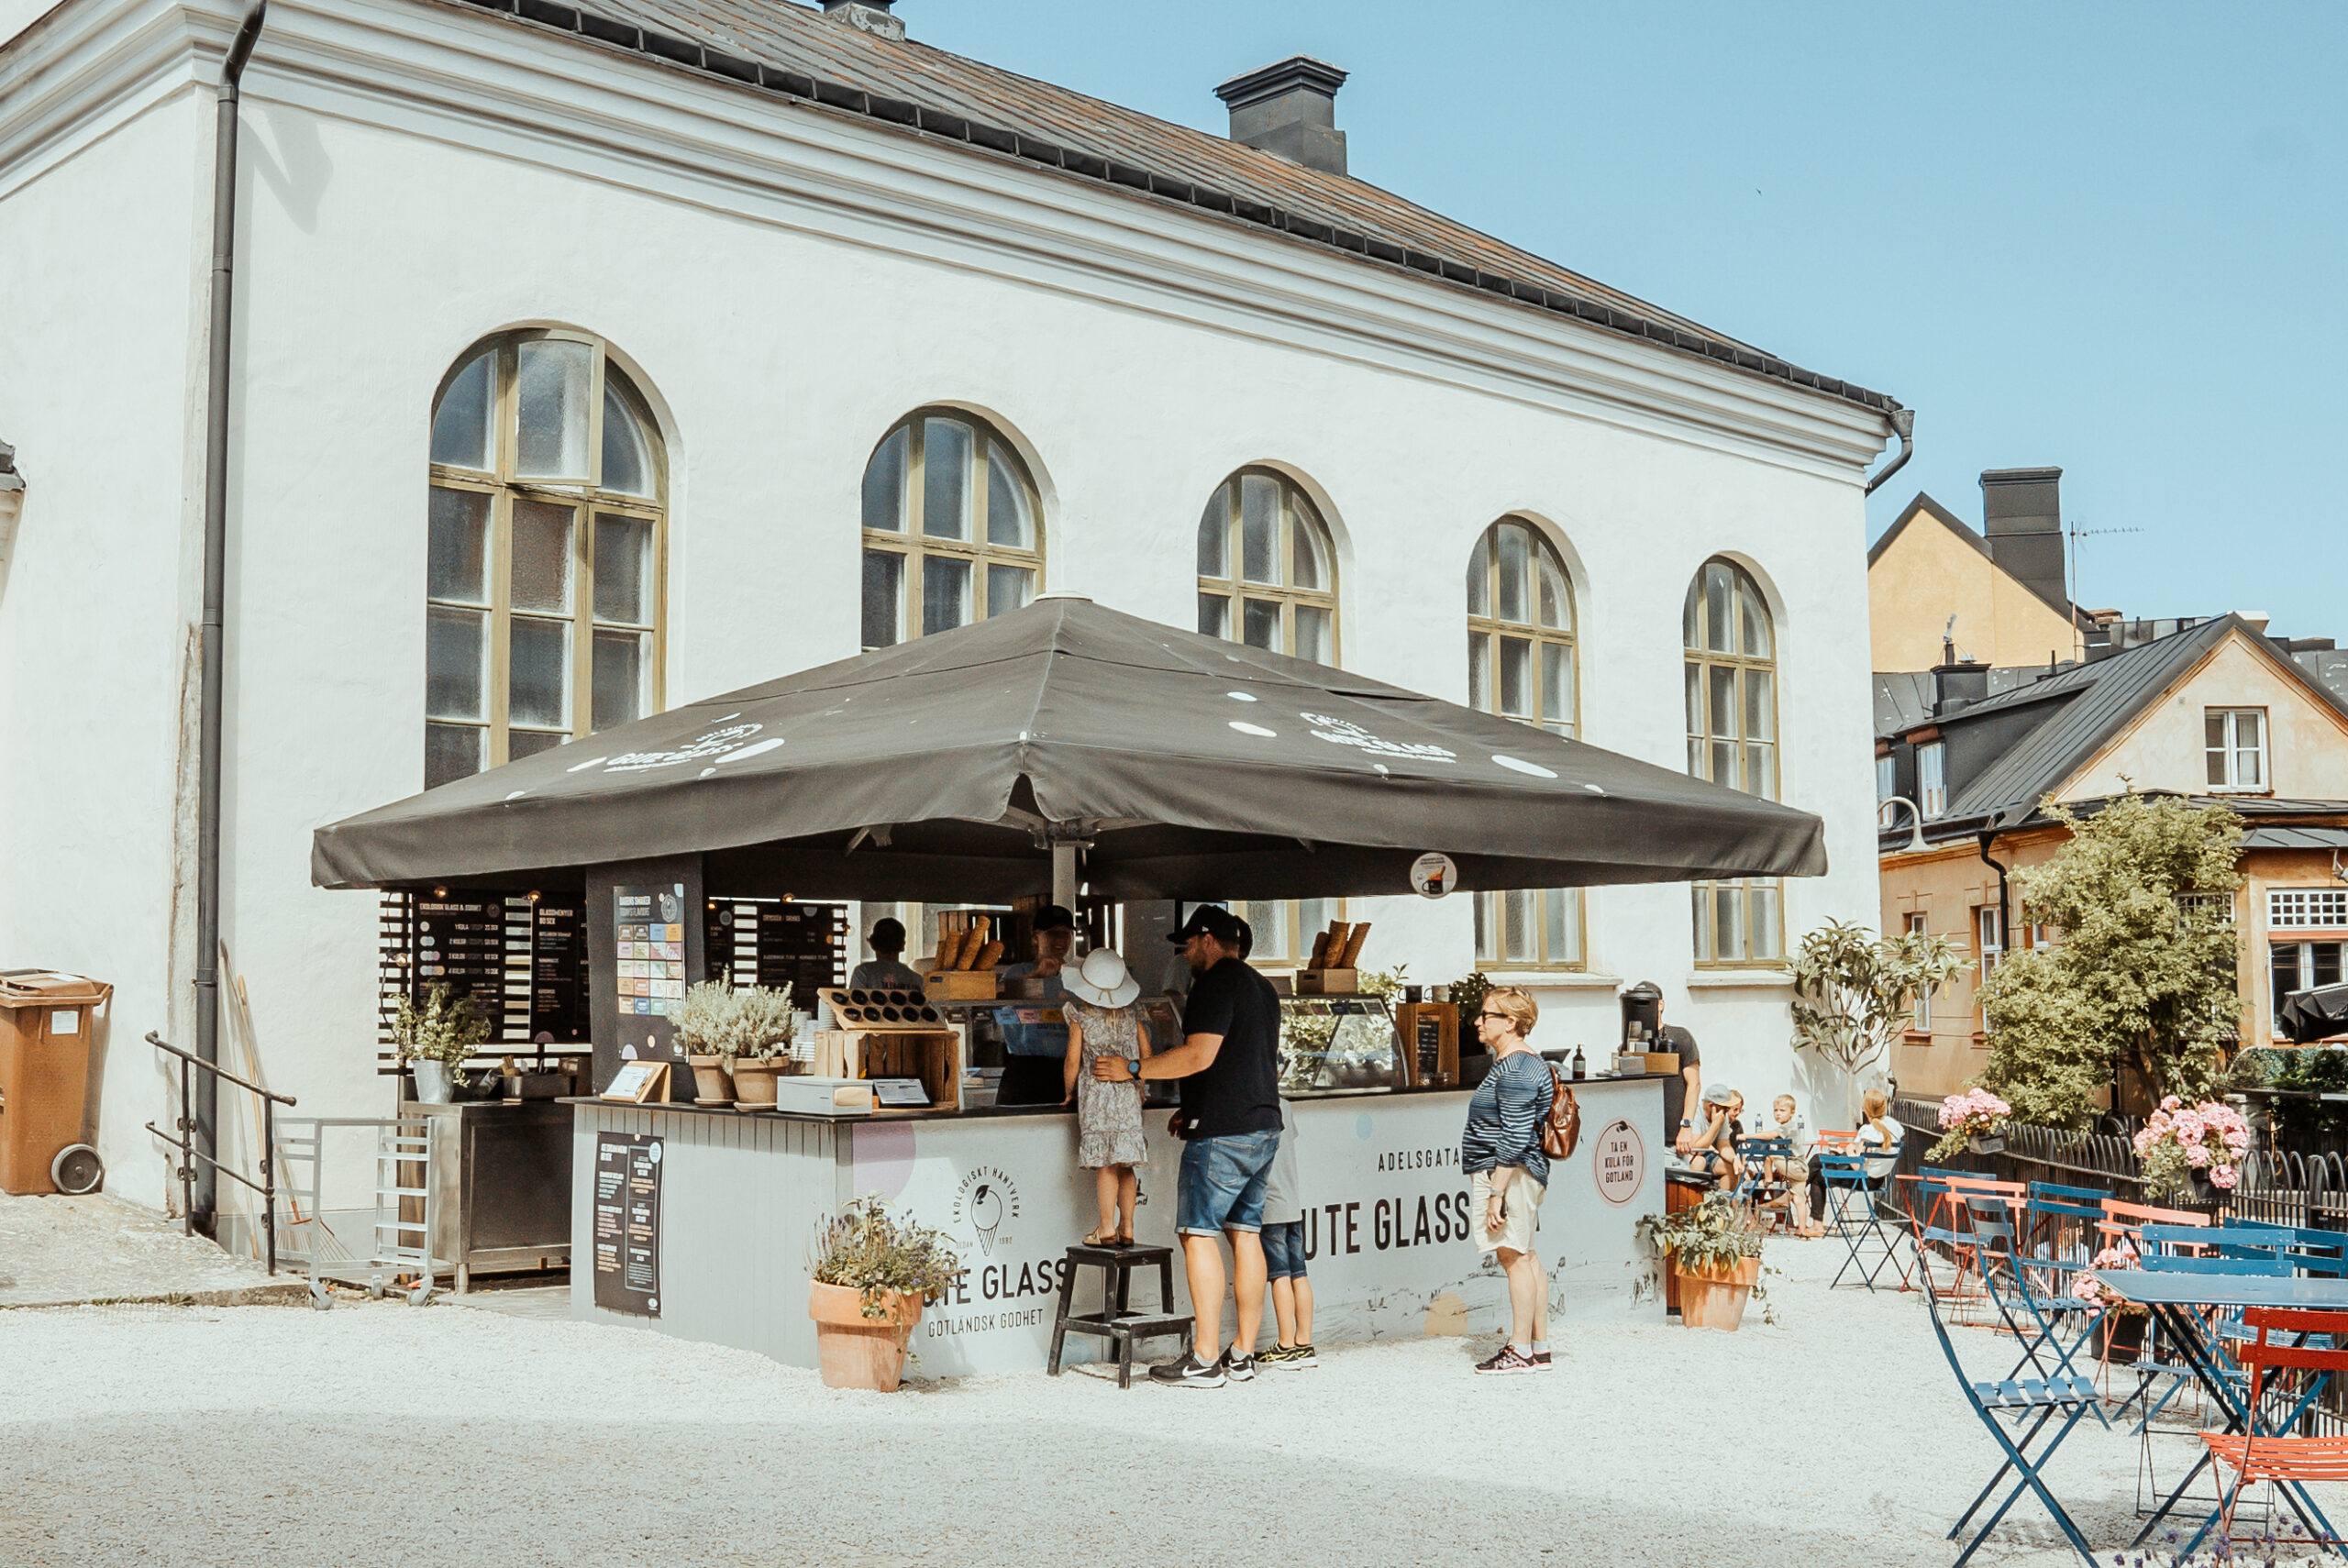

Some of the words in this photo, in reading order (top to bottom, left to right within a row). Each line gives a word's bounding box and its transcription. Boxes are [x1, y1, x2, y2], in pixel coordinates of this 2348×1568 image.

[1378, 1147, 1460, 1172] ADELSGATA
[1611, 1142, 1618, 1153] TA
[1620, 1141, 1628, 1153] EN
[1604, 1156, 1620, 1168] KULA
[1605, 1170, 1634, 1184] GOTLAND
[953, 1166, 988, 1223] EKOLOGISKT
[992, 1167, 1020, 1218] HANTVERK
[1301, 1201, 1361, 1261] UTE
[1374, 1190, 1470, 1251] GLASS
[982, 1258, 1068, 1300] GLASS
[928, 1313, 995, 1338] GOTLÄNDSK
[1000, 1309, 1044, 1329] GODHET
